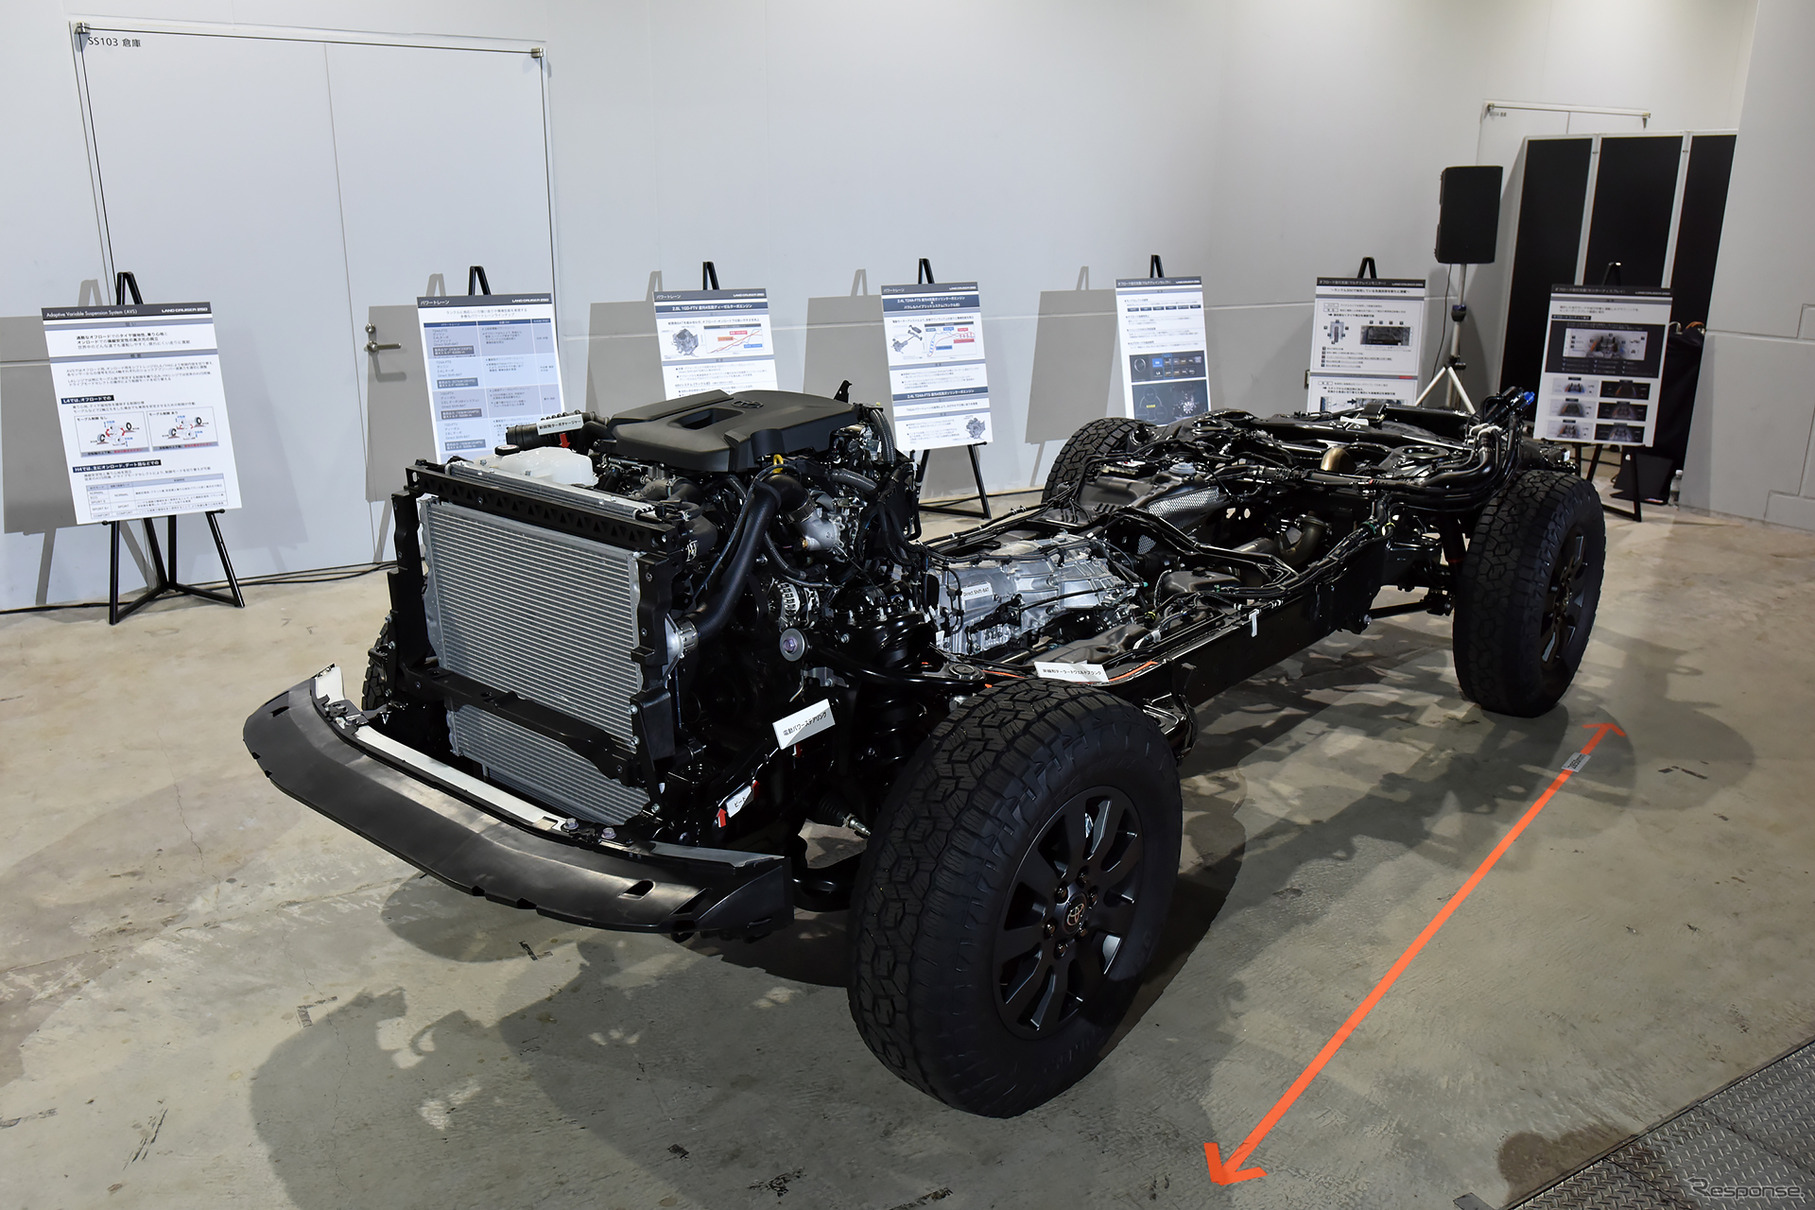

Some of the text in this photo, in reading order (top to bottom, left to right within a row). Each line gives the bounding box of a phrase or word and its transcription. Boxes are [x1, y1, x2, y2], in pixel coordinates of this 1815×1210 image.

[88, 37, 141, 48] SS103 倉庫
[783, 711, 827, 736] 電動パワーステアリング
